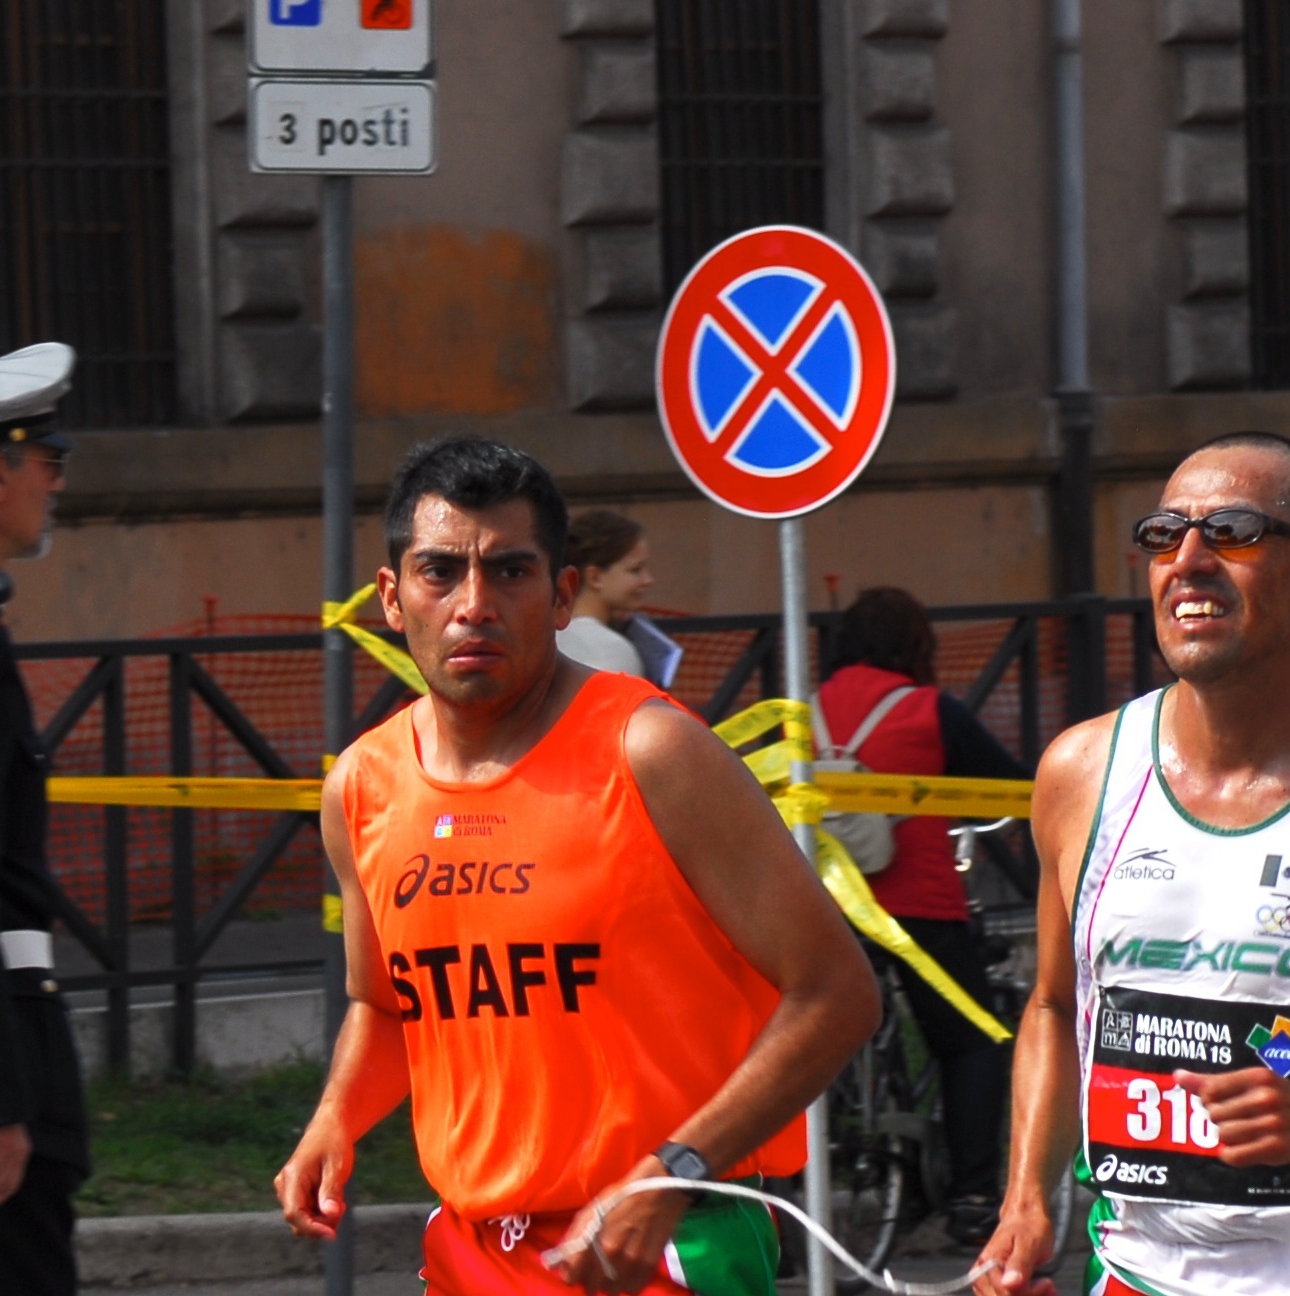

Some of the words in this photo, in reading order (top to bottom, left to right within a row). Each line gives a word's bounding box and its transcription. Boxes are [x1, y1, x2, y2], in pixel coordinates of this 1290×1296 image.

[279, 113, 297, 145] 3
[317, 108, 408, 156] posti
[1113, 865, 1176, 881] atletica
[388, 943, 601, 1023] STAFF
[1135, 1013, 1232, 1045] MARATONA
[1134, 1034, 1151, 1055] di
[1153, 1036, 1207, 1061] ROMA
[1210, 1045, 1232, 1065] 18
